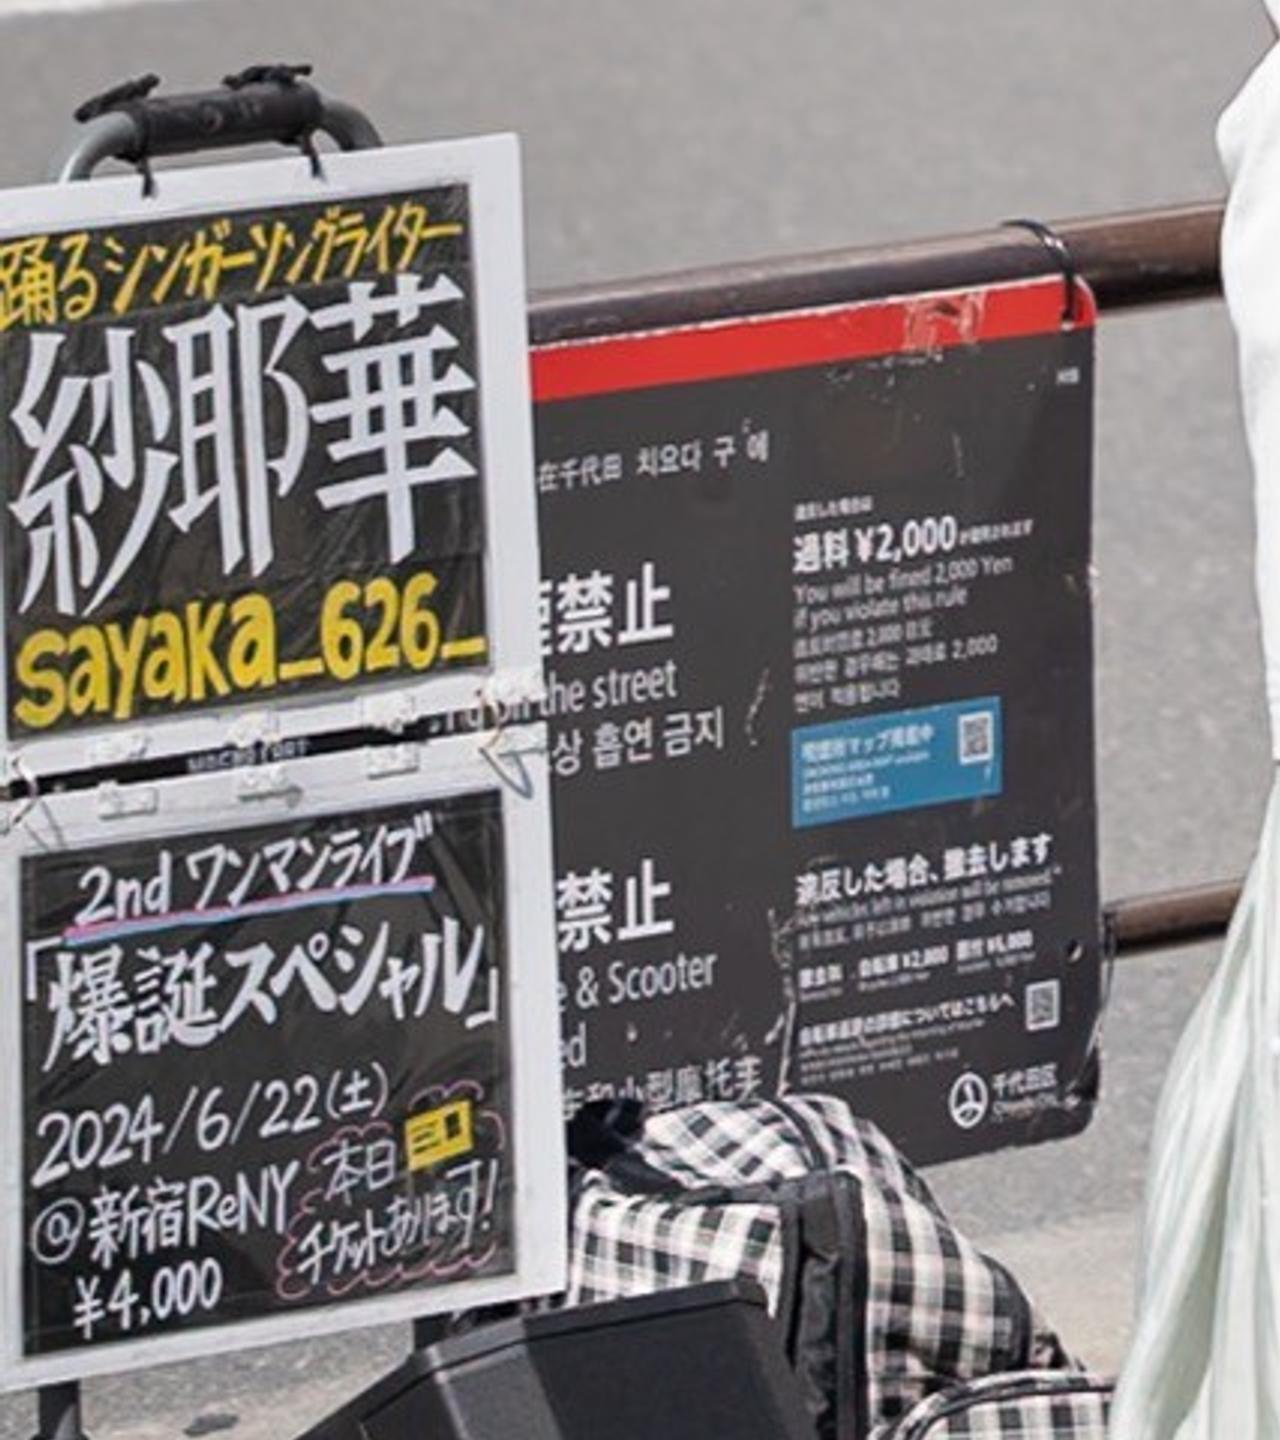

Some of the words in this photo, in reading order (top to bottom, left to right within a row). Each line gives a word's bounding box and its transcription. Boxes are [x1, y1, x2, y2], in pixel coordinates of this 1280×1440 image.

[8, 272, 478, 617] 紗耶華
[854, 514, 958, 564] ¥2,000
[864, 573, 885, 595] be
[981, 556, 1013, 576] Yen
[811, 605, 842, 634] you
[935, 584, 968, 608] rule
[14, 572, 486, 728] sayaka_626_
[592, 659, 679, 709] street
[549, 727, 584, 777] 상
[663, 704, 724, 758] 금지
[73, 850, 172, 925] 2nd
[186, 811, 434, 912] ワンマンライブ
[556, 858, 675, 953] 禁止
[575, 965, 600, 1010] &
[607, 952, 718, 1004] Scooter
[74, 1256, 223, 1340] ¥4,000
